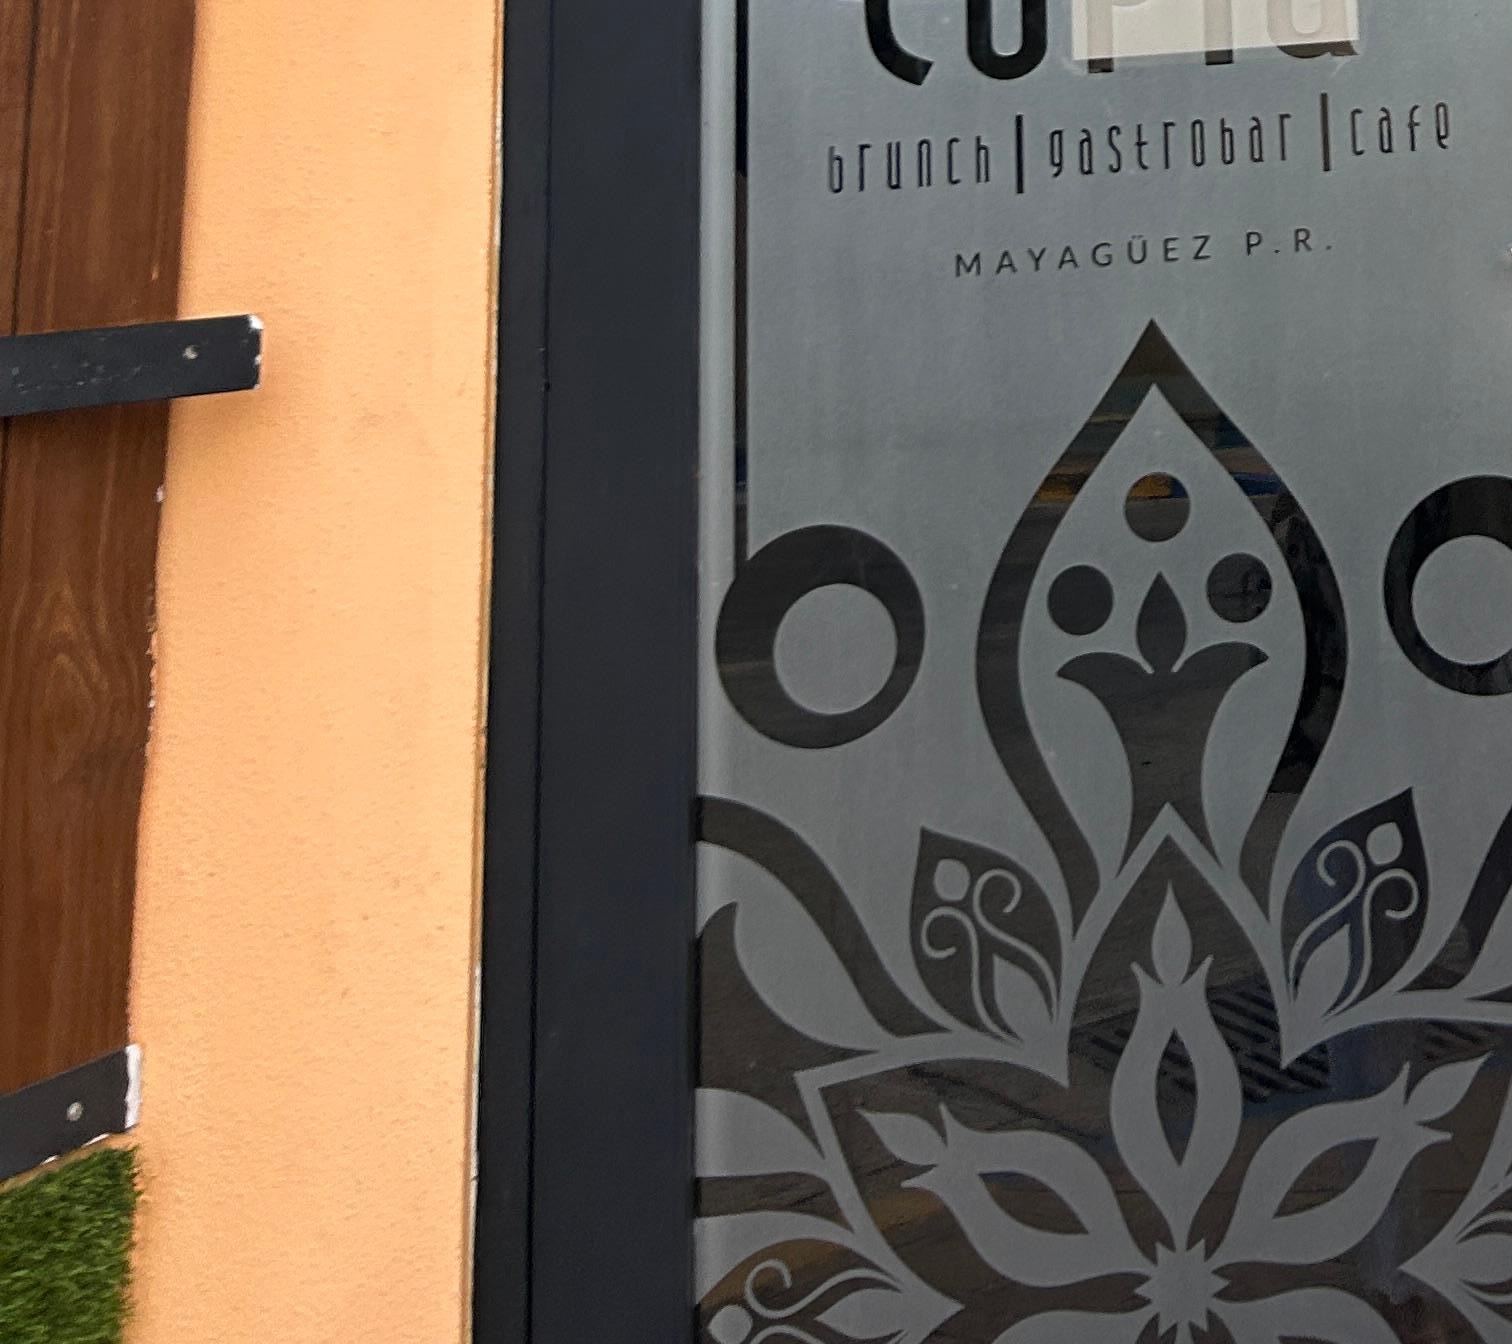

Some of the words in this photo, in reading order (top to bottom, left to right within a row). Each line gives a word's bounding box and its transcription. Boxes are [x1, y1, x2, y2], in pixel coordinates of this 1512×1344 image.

[827, 134, 992, 194] brunch
[1048, 112, 1293, 179] gastrobar
[1349, 101, 1451, 157] cafe
[954, 234, 1213, 278] MAYAGÜEZ
[1245, 227, 1333, 256] P.R.
